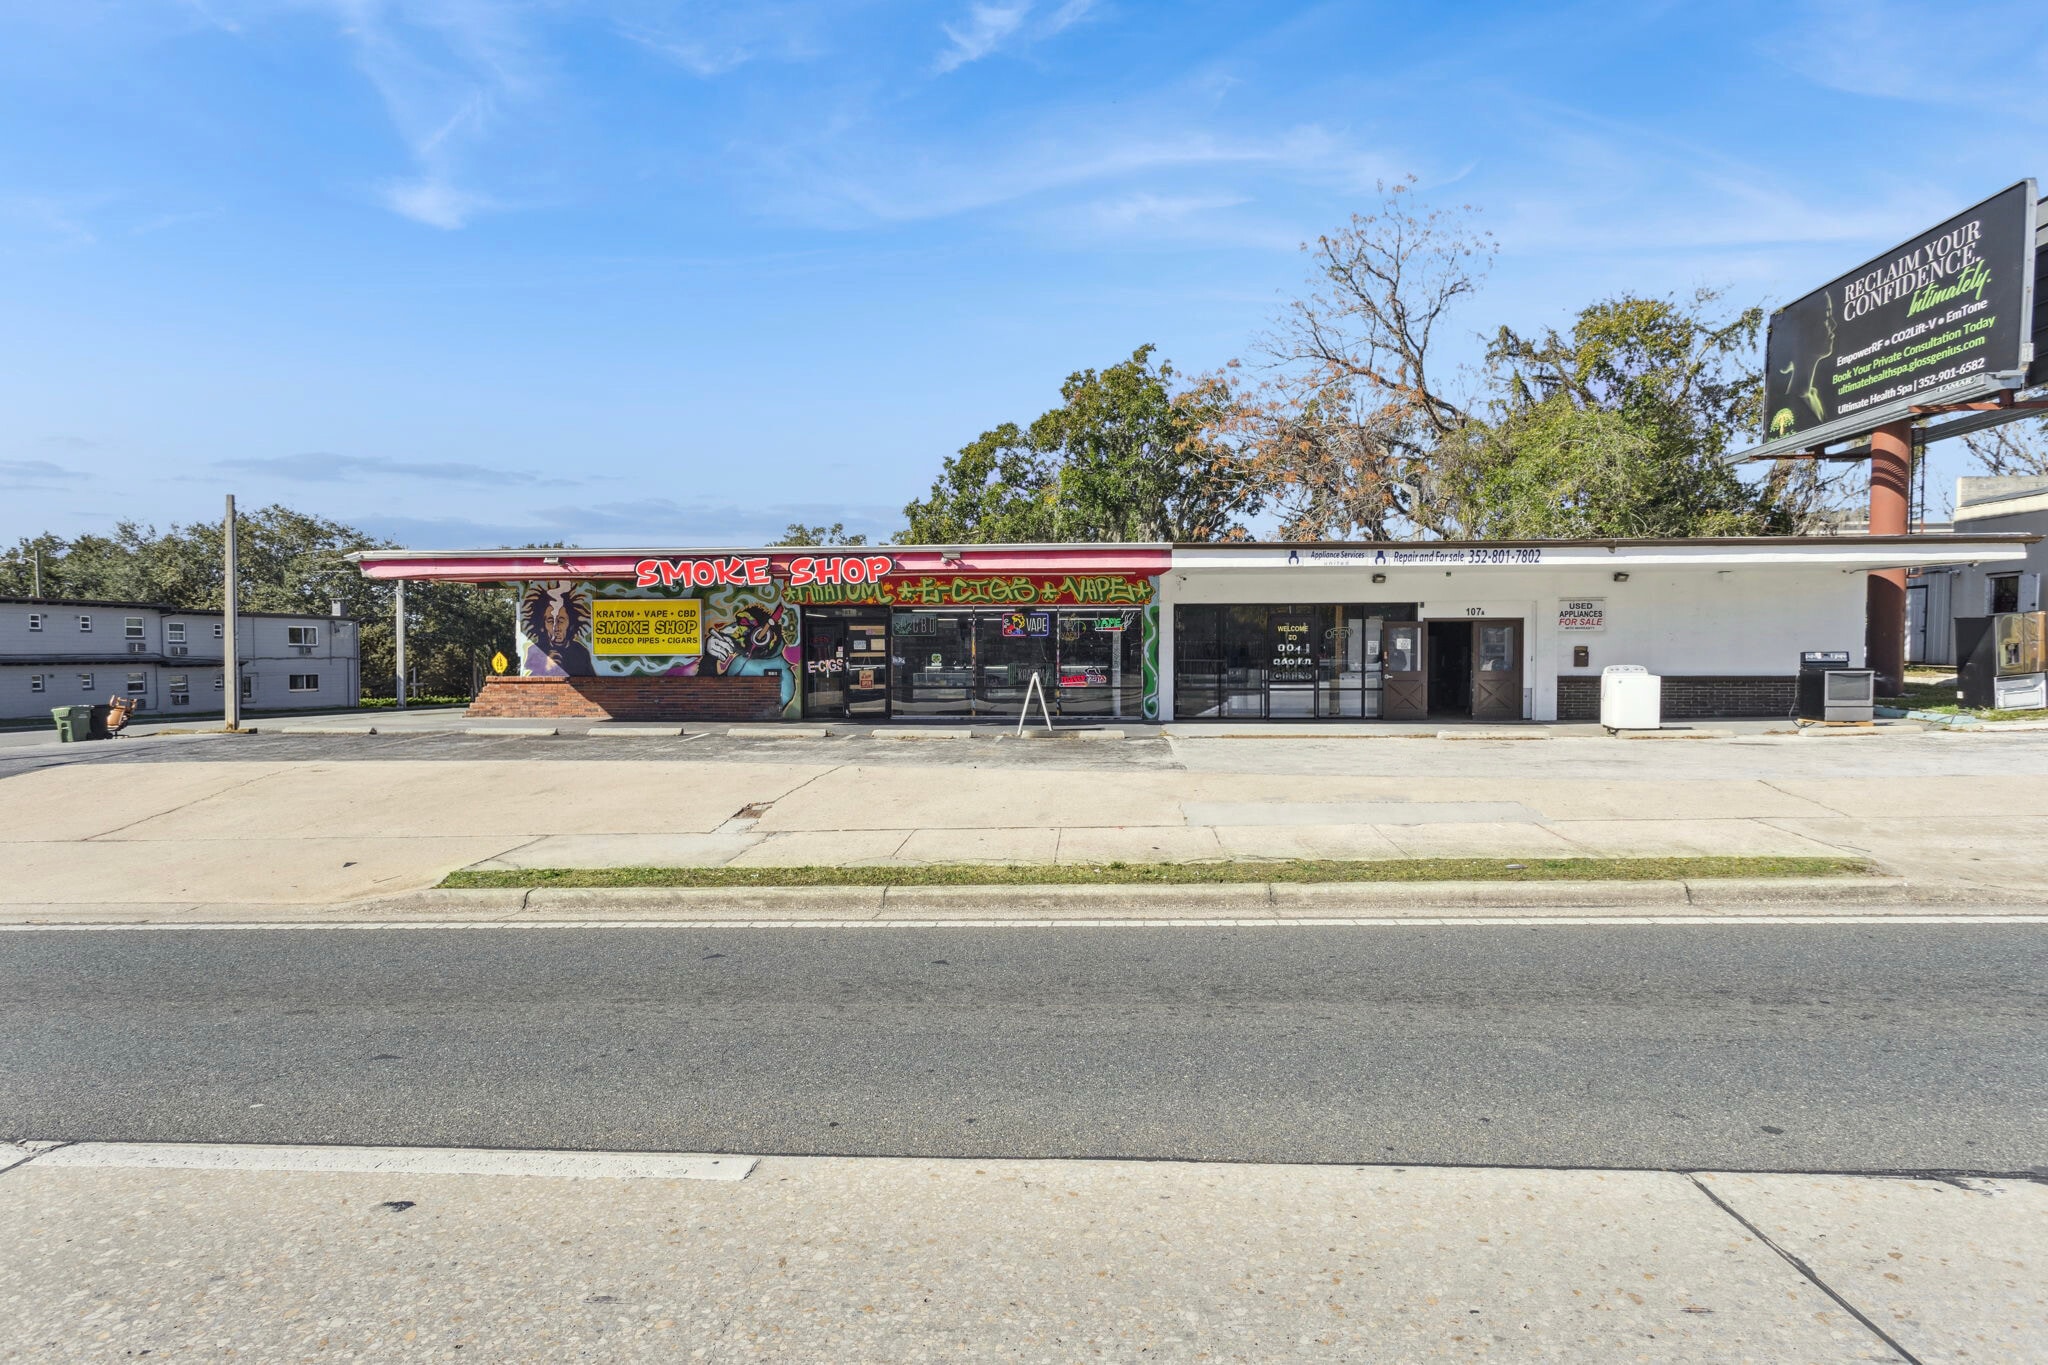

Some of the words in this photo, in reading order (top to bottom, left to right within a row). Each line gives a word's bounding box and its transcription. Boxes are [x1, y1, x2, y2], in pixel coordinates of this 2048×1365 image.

[1844, 249, 1921, 304] RECLAIM
[1925, 220, 1982, 263] YOUR
[1843, 242, 1982, 322] CONFIDENCE.
[1906, 259, 1992, 318] Intimately.
[1836, 339, 1884, 367] EmpowerRF
[1891, 317, 1938, 345] CO2Lift-V
[1946, 299, 1988, 323] EmTone
[1832, 370, 1852, 384] Book
[1853, 362, 1872, 377] Your
[1873, 351, 1902, 369] Private
[1904, 330, 1962, 357] Consultation
[1963, 315, 1996, 335] Today
[1838, 336, 1986, 395] ultimatehealthspa.glossgenius.com
[1838, 398, 1869, 414] Ultimate
[1870, 387, 1896, 404] Health
[1897, 384, 1913, 396] Spa
[1918, 357, 1986, 389] 352-901-6582
[1311, 551, 1339, 560] Appliance
[1340, 550, 1365, 559] Services
[1394, 551, 1419, 564] Repair
[1419, 551, 1434, 562] and
[1435, 551, 1449, 562] For
[1450, 551, 1465, 562] sale
[1468, 549, 1541, 564] 352-801-7802
[635, 556, 772, 588] SMOKE
[789, 555, 893, 587] SHOP
[1569, 602, 1593, 610] USED
[596, 610, 634, 618] KRATOM
[644, 610, 668, 618] VAPE
[678, 610, 696, 618] CBD
[1559, 610, 1603, 618] APPLIANCES
[596, 620, 649, 635] SMOKE
[655, 620, 697, 635] SHOP
[1026, 617, 1047, 632] VAPE
[1093, 618, 1122, 628] VAPE
[1558, 618, 1578, 626] FOR
[1579, 618, 1603, 626] SALE
